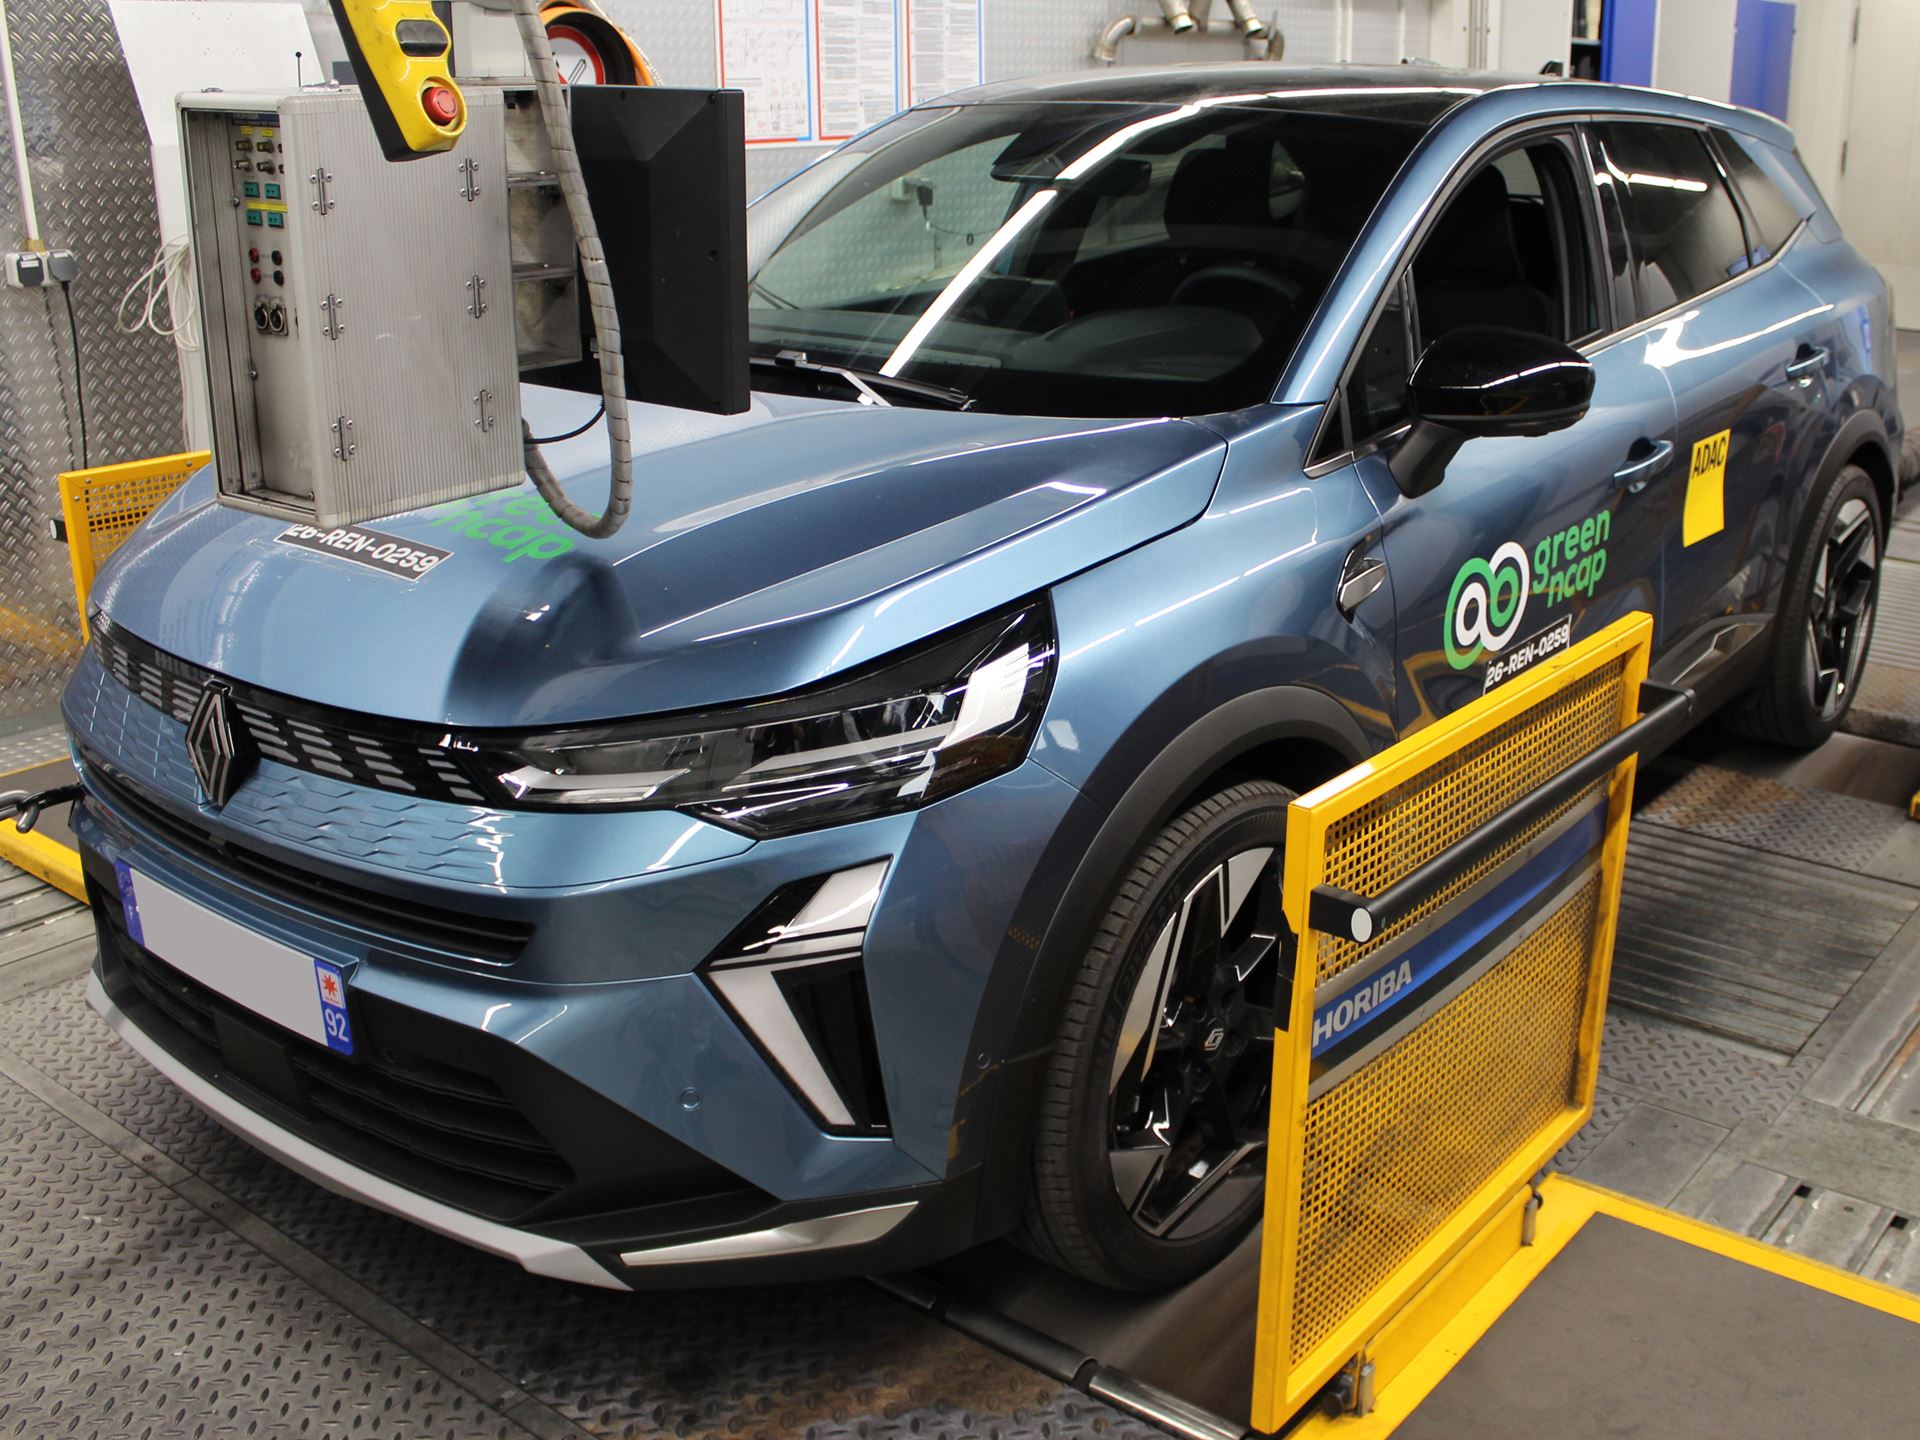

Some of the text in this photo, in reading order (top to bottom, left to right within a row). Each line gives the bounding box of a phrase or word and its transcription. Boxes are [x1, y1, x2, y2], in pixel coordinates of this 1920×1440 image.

[1692, 436, 1726, 479] ADAC
[286, 523, 440, 573] 26-REN-0259
[431, 508, 576, 564] ncap
[1533, 509, 1611, 594] green
[1547, 548, 1607, 608] ncap
[1485, 624, 1569, 689] 26-REN-0259
[325, 1008, 349, 1042] 92
[1312, 960, 1412, 1048] HORIBA
